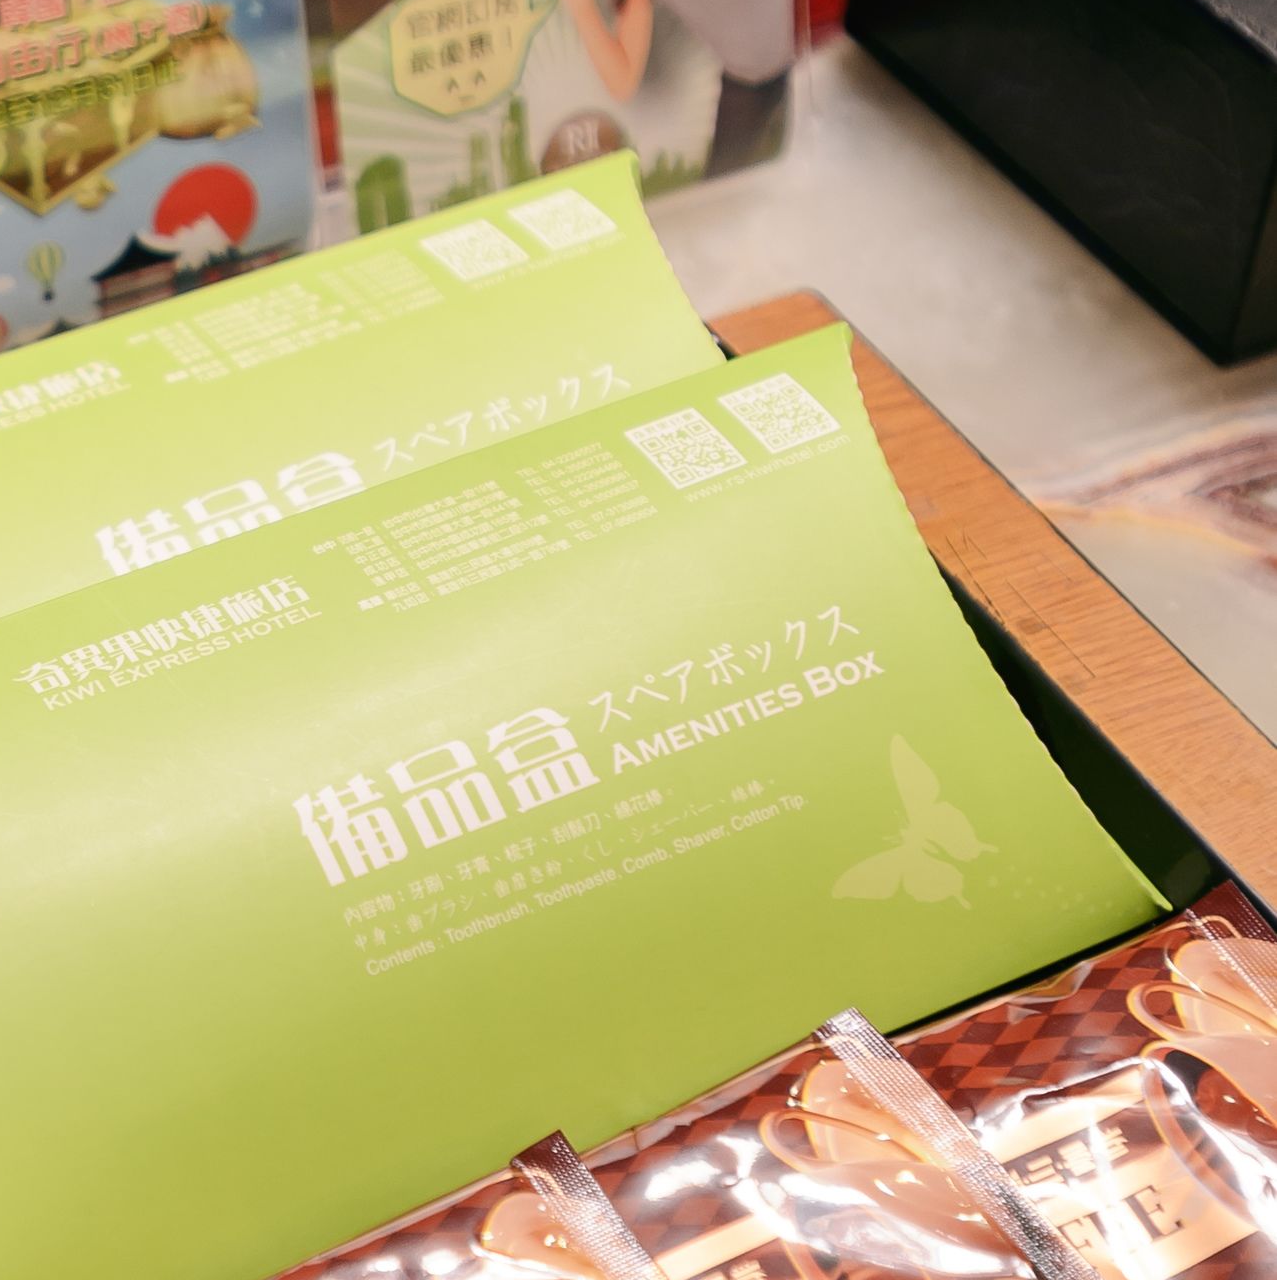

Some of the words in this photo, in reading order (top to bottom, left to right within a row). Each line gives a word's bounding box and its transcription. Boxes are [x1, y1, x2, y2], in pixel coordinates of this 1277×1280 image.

[47, 380, 131, 416] HOTEL
[372, 363, 632, 472] スペアボックス
[13, 575, 311, 696] 奇異果快捷旅店
[41, 679, 106, 711] KIWI
[110, 637, 230, 689] EXPRESS
[232, 606, 322, 645] HOTEL
[587, 604, 860, 734] スペアボックス
[611, 680, 804, 775] AMENITIES
[292, 705, 601, 887] 備品盒
[365, 934, 439, 977] Contents
[444, 902, 535, 947] Toothbrush,
[533, 867, 624, 910] Toothpaste,
[623, 844, 674, 875] Comb,
[673, 823, 731, 858] Shaver,
[732, 800, 782, 832] Cotton
[780, 791, 810, 821] Tip.
